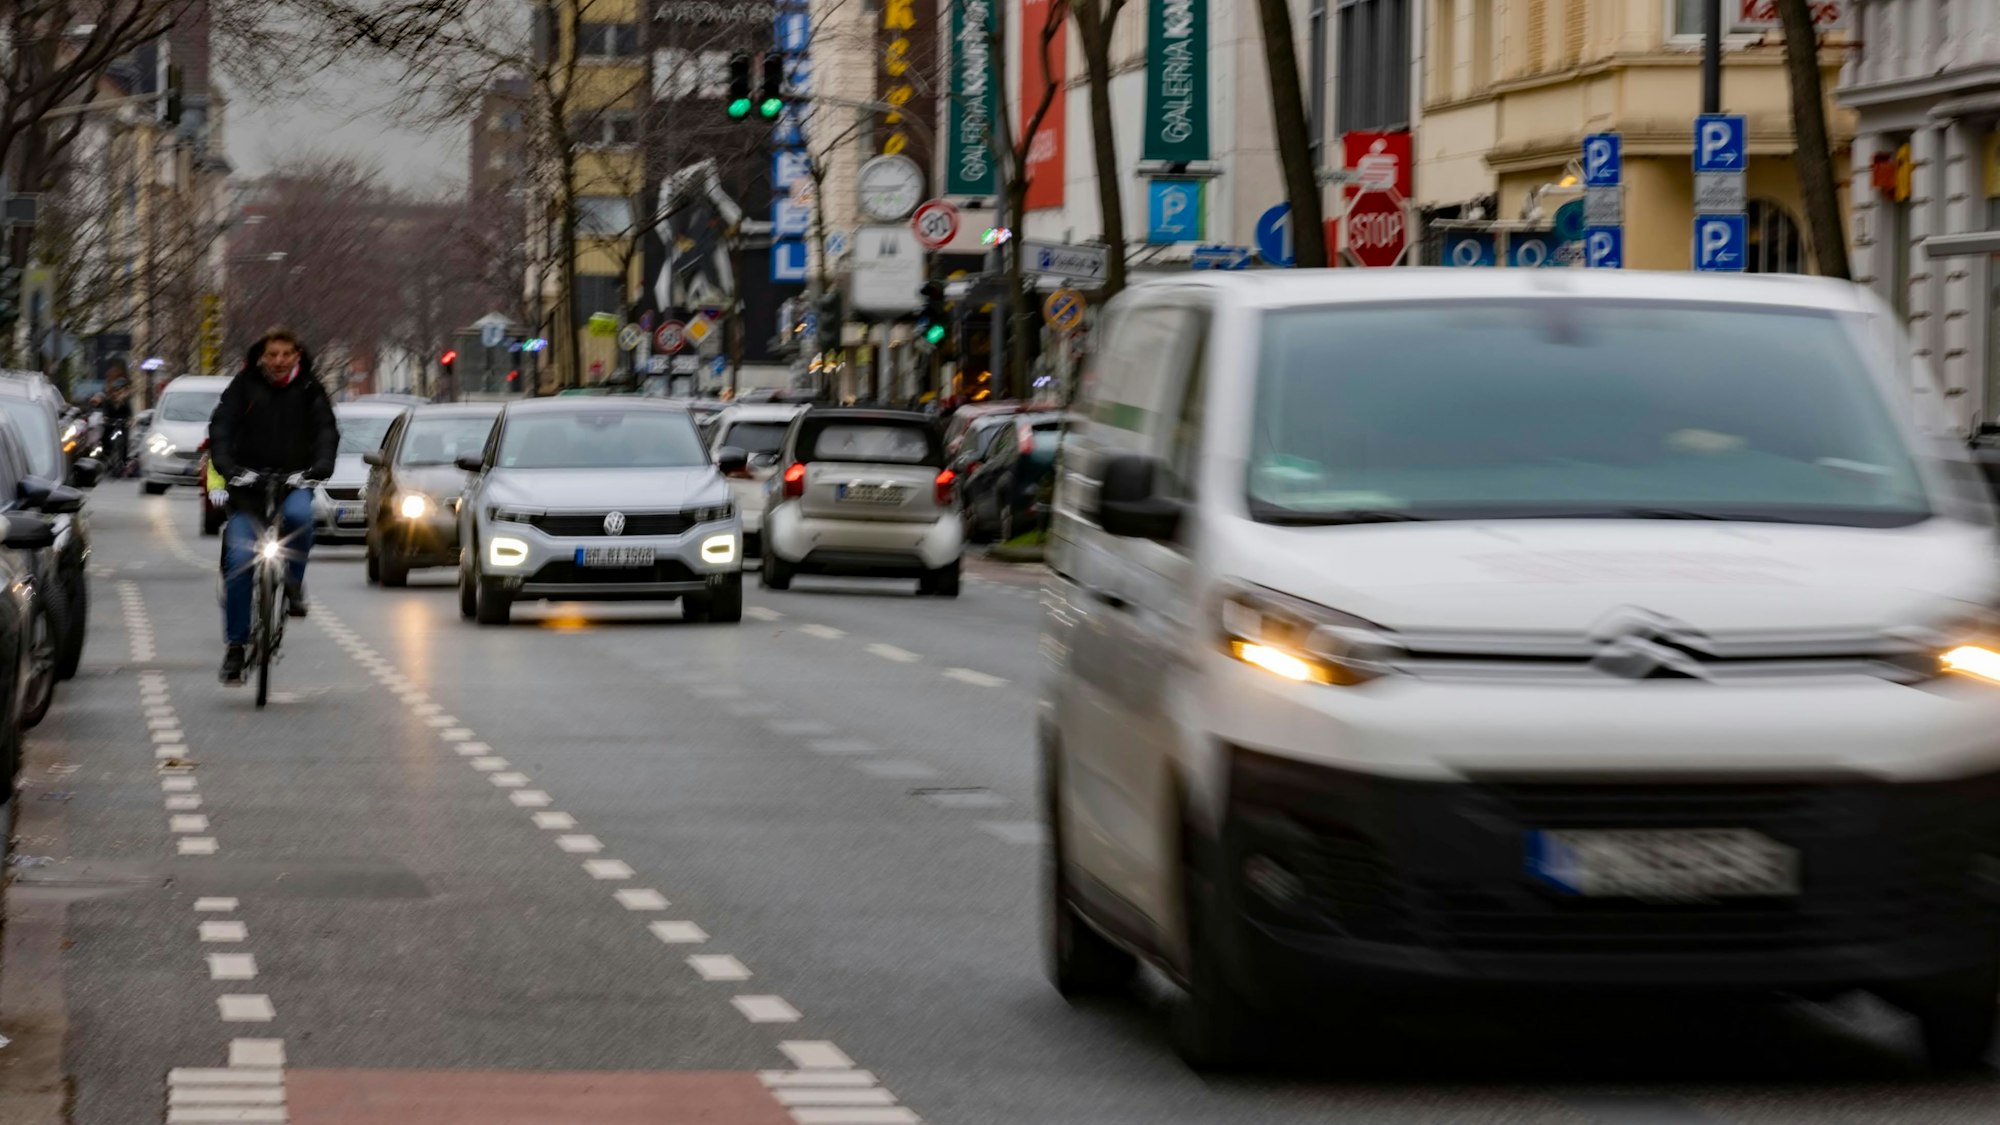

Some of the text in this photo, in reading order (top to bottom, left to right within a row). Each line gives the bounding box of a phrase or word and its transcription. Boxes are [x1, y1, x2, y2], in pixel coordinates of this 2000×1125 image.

[1161, 39, 1194, 143] GALERIA
[960, 95, 988, 182] GALERIA
[1587, 139, 1612, 181] P
[1702, 121, 1732, 166] P
[1162, 192, 1188, 227] P
[1350, 211, 1404, 250] STOP
[1587, 231, 1613, 266] P
[1702, 220, 1732, 265] P
